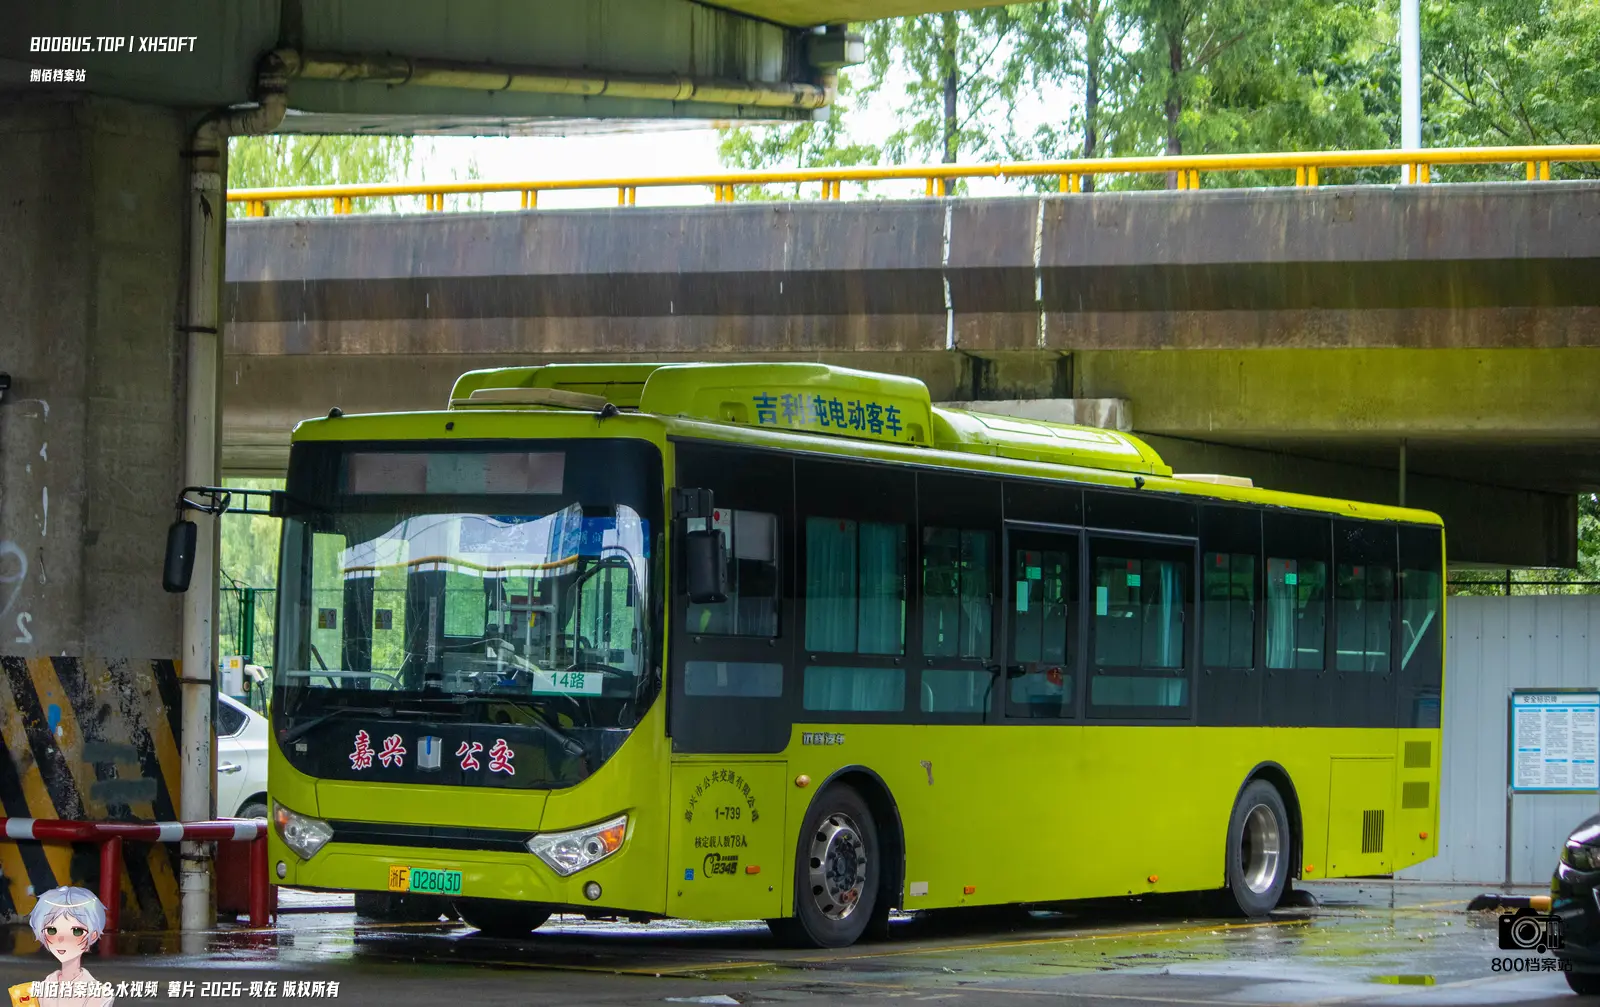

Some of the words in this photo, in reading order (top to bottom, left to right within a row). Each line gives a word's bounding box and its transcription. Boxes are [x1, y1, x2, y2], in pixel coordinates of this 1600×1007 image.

[753, 392, 902, 437] 吉利纯电动客车
[551, 672, 585, 689] 14路
[349, 729, 407, 771] 嘉兴
[455, 738, 515, 775] 公交
[715, 806, 741, 820] 1-739
[711, 862, 738, 875] 12345
